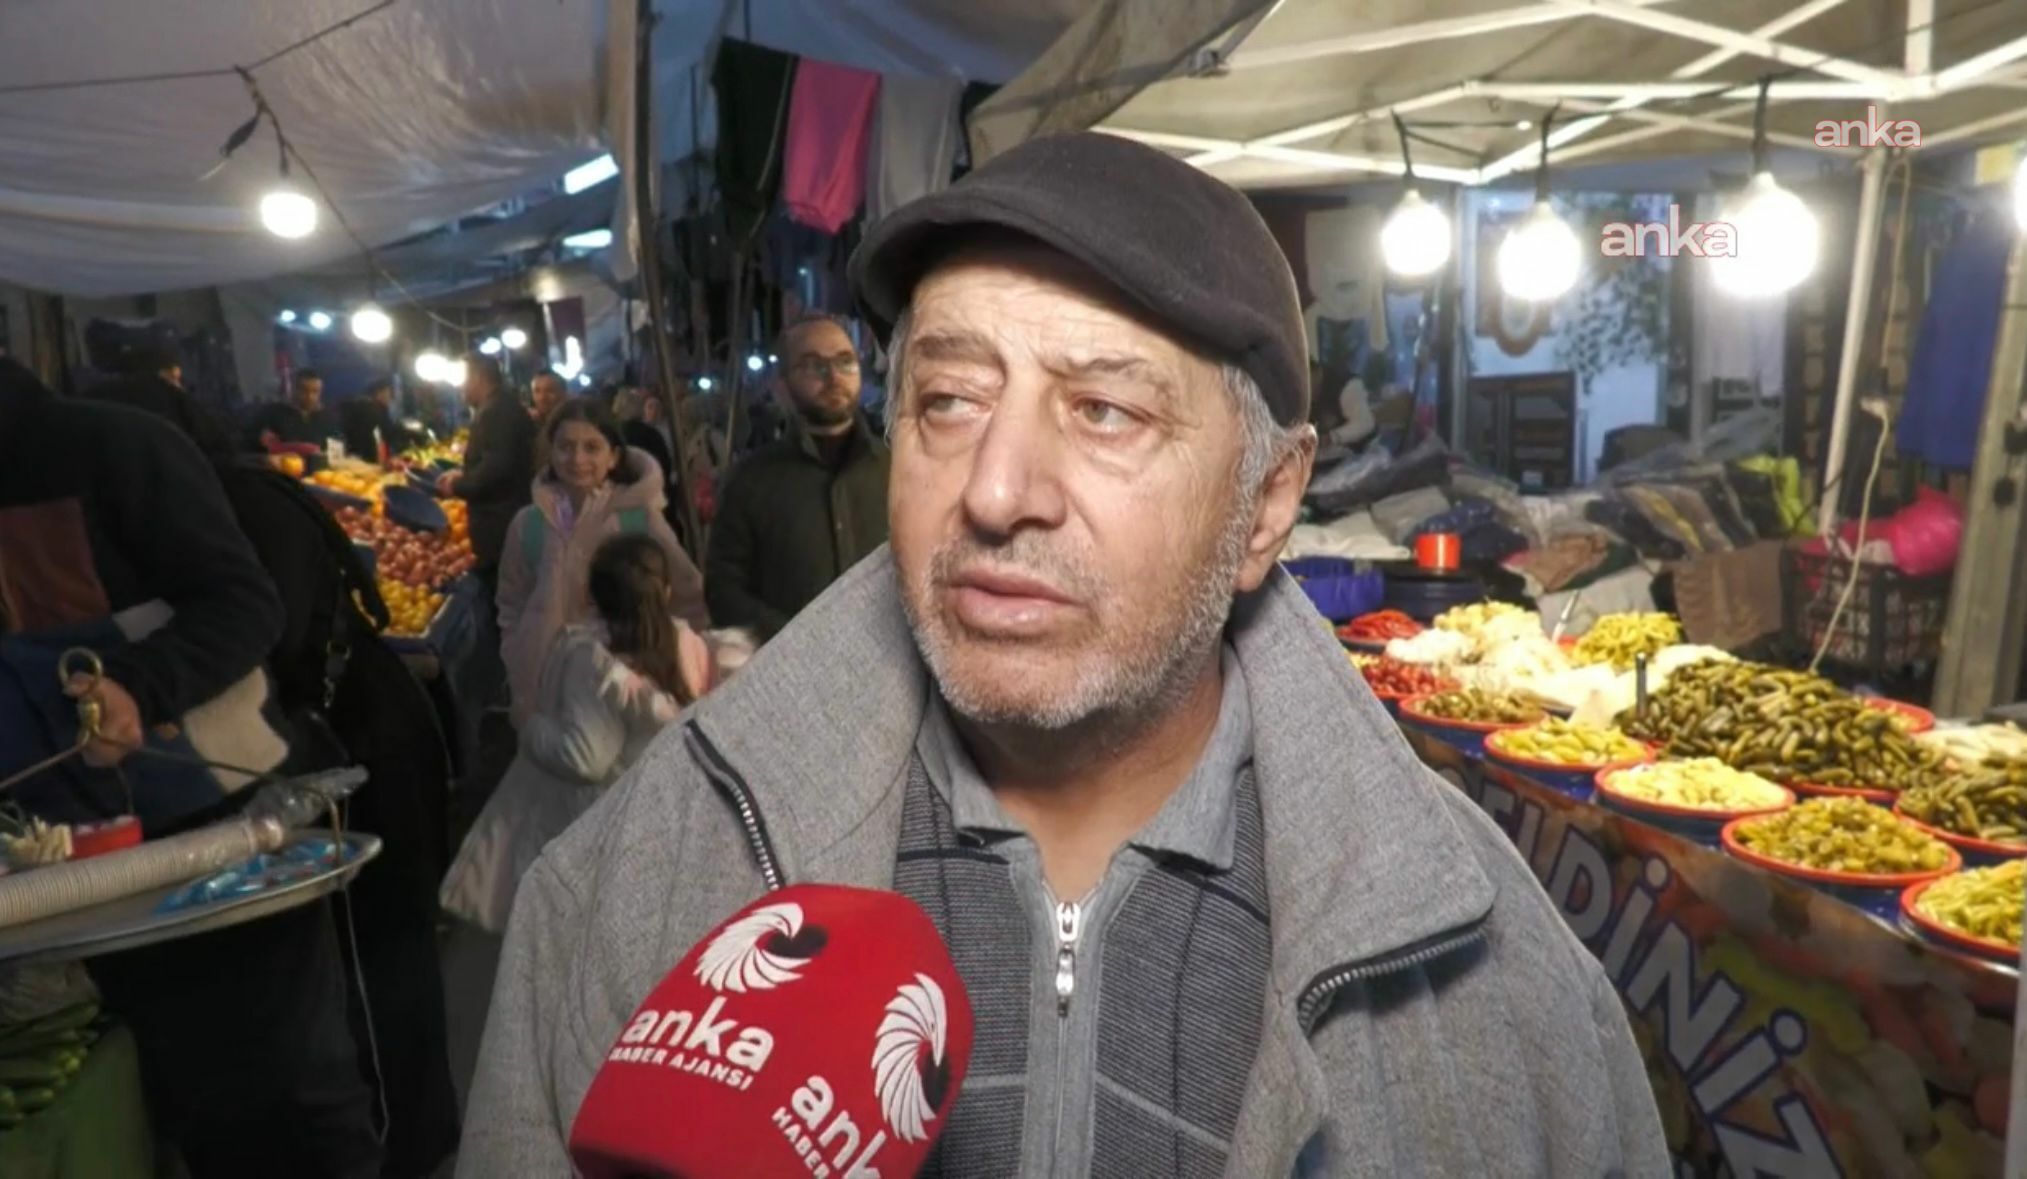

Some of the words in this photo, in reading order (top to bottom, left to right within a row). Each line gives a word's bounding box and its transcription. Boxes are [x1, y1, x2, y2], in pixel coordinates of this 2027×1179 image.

[621, 995, 774, 1072] anka
[608, 1046, 668, 1065] HABER
[668, 1053, 755, 1091] AJANSI
